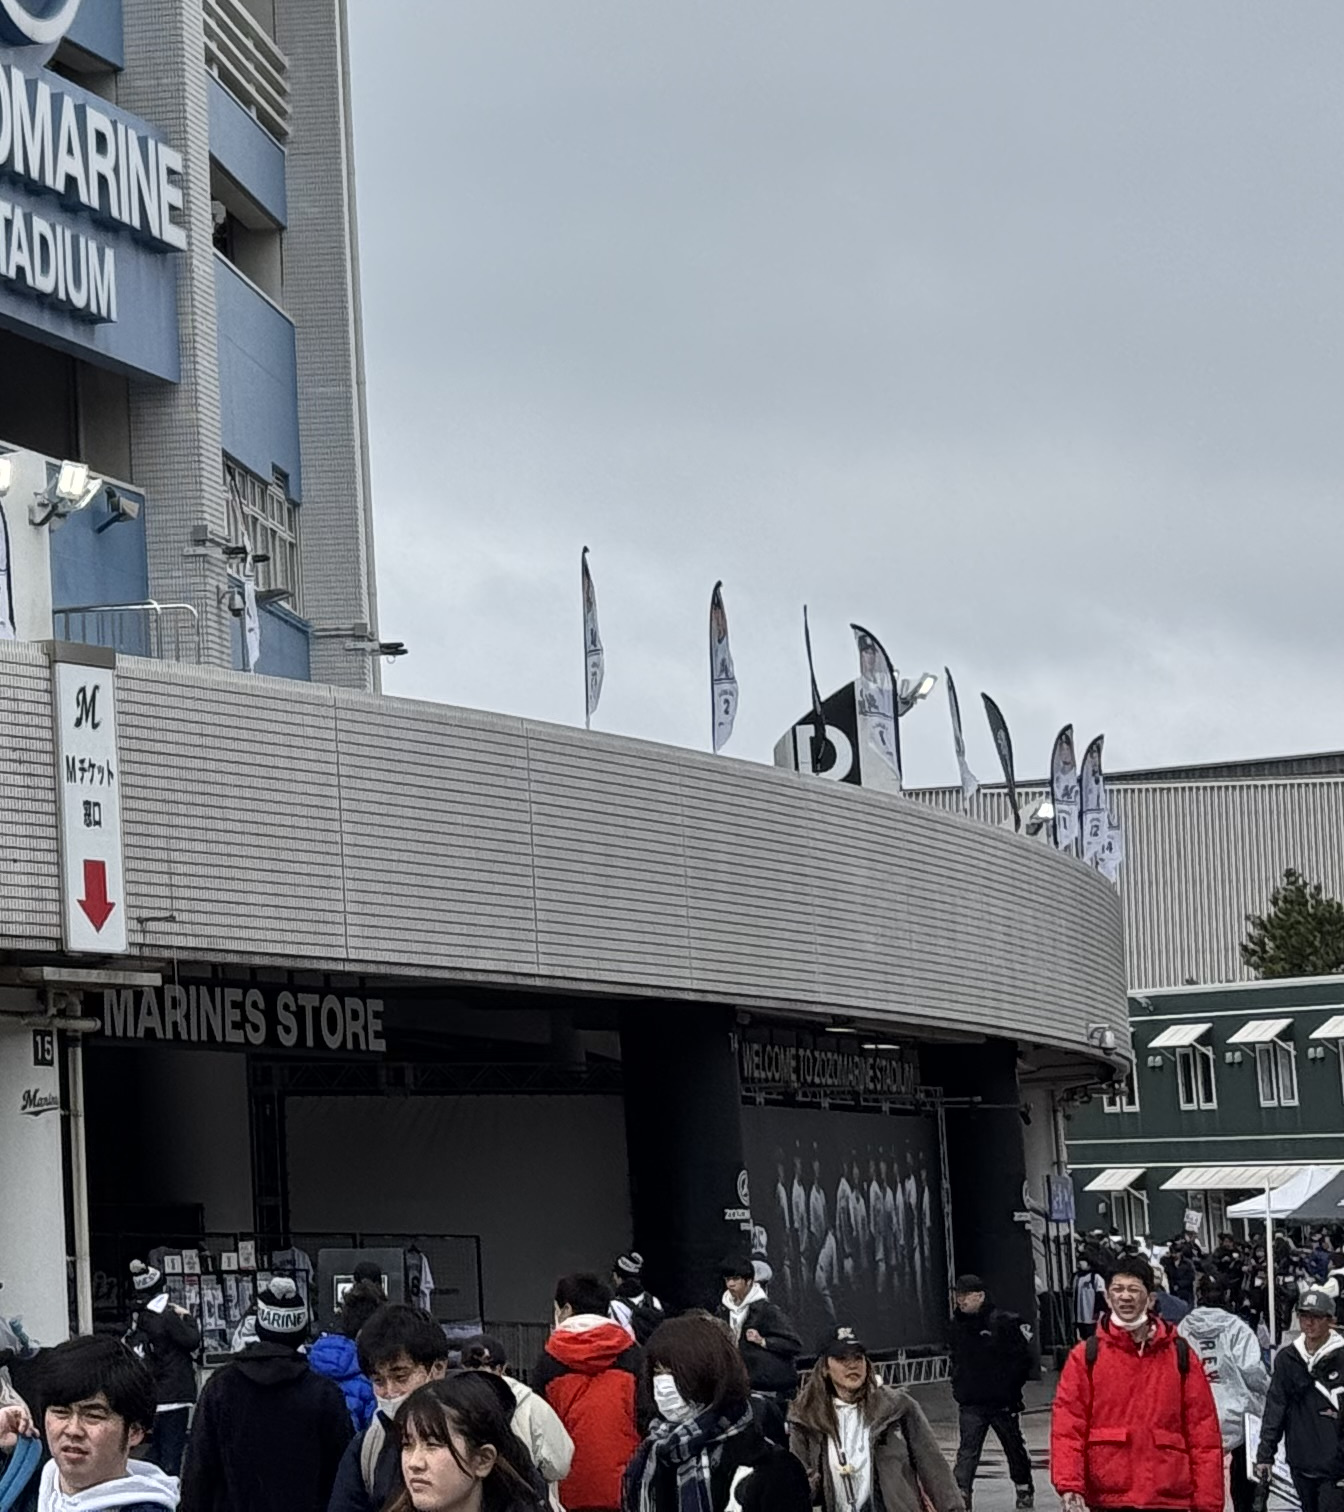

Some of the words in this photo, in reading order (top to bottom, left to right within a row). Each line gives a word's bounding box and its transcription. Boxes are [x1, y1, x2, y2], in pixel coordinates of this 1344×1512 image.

[66, 755, 113, 788] Mチケット
[103, 984, 267, 1045] MARINES
[276, 990, 387, 1053] STORE
[35, 1035, 52, 1060] 15
[742, 1041, 797, 1082] WELCOME
[798, 1048, 813, 1084] TO
